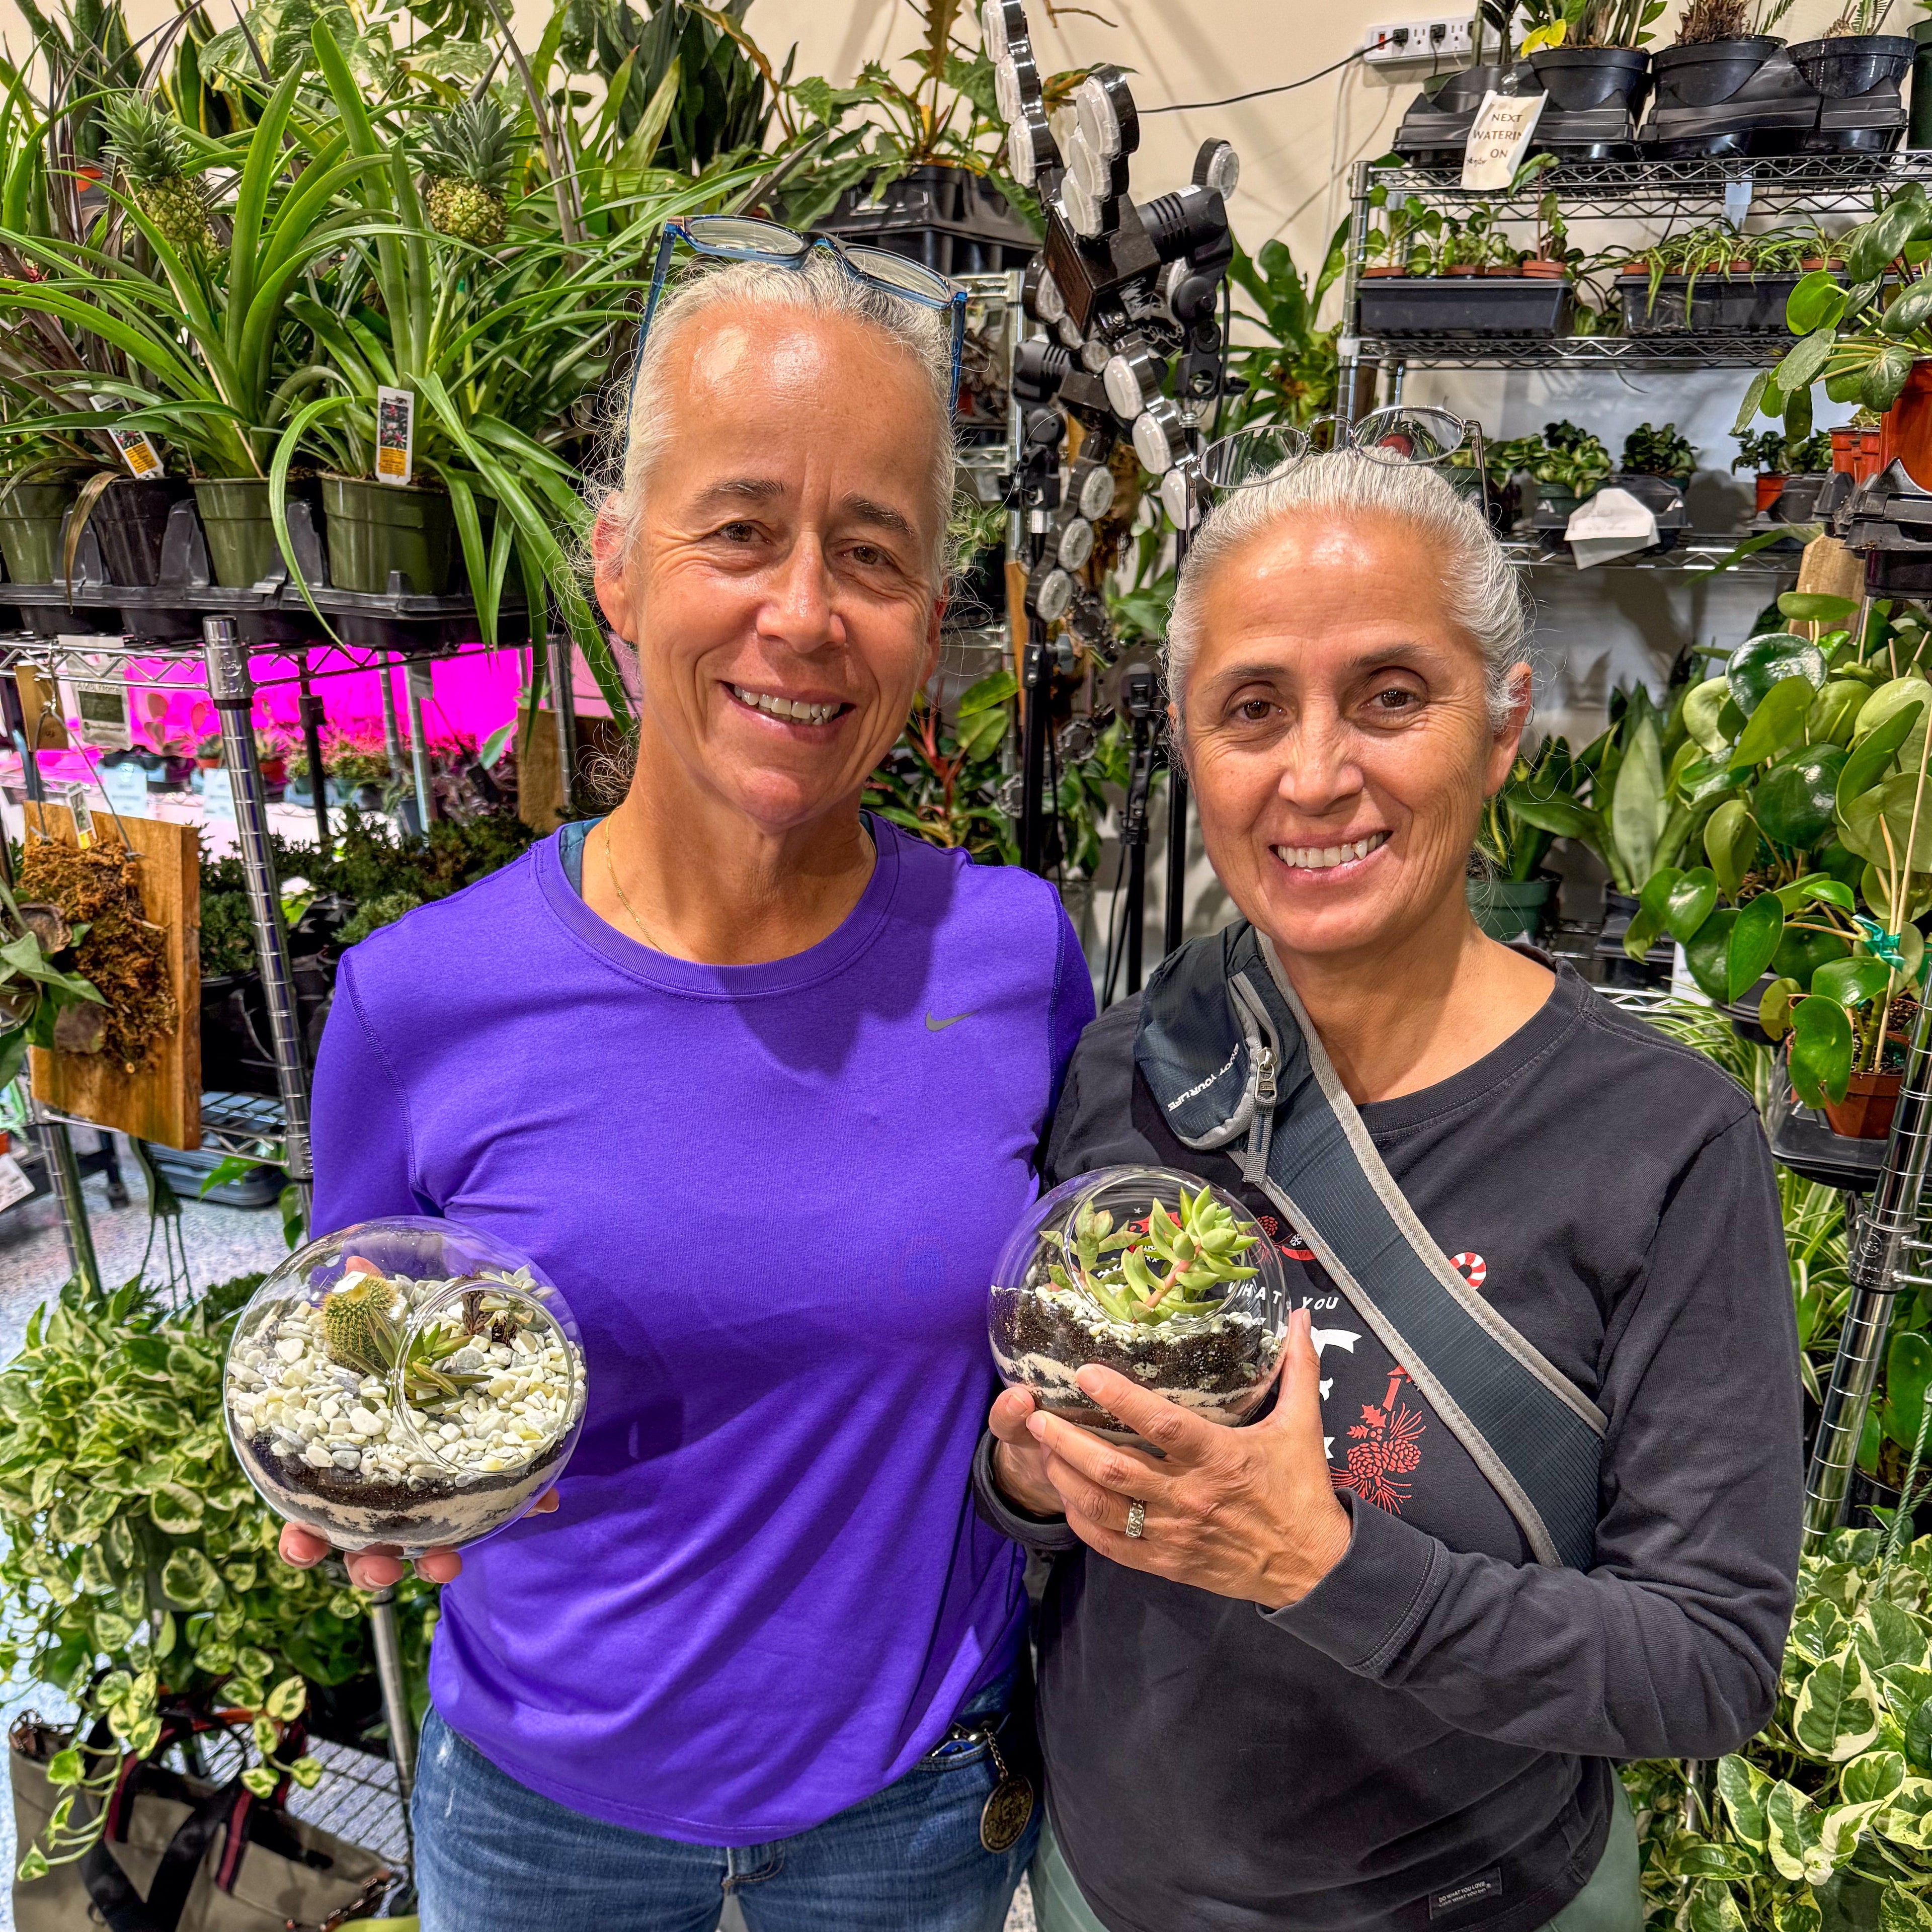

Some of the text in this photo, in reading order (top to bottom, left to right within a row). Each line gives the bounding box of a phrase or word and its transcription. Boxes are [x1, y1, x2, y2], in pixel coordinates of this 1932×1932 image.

[1491, 114, 1523, 122] NEXT
[1490, 148, 1508, 158] ON
[1189, 1074, 1217, 1096] YOUR
[1167, 1091, 1190, 1112] LIFE
[1302, 1297, 1339, 1310] YOU
